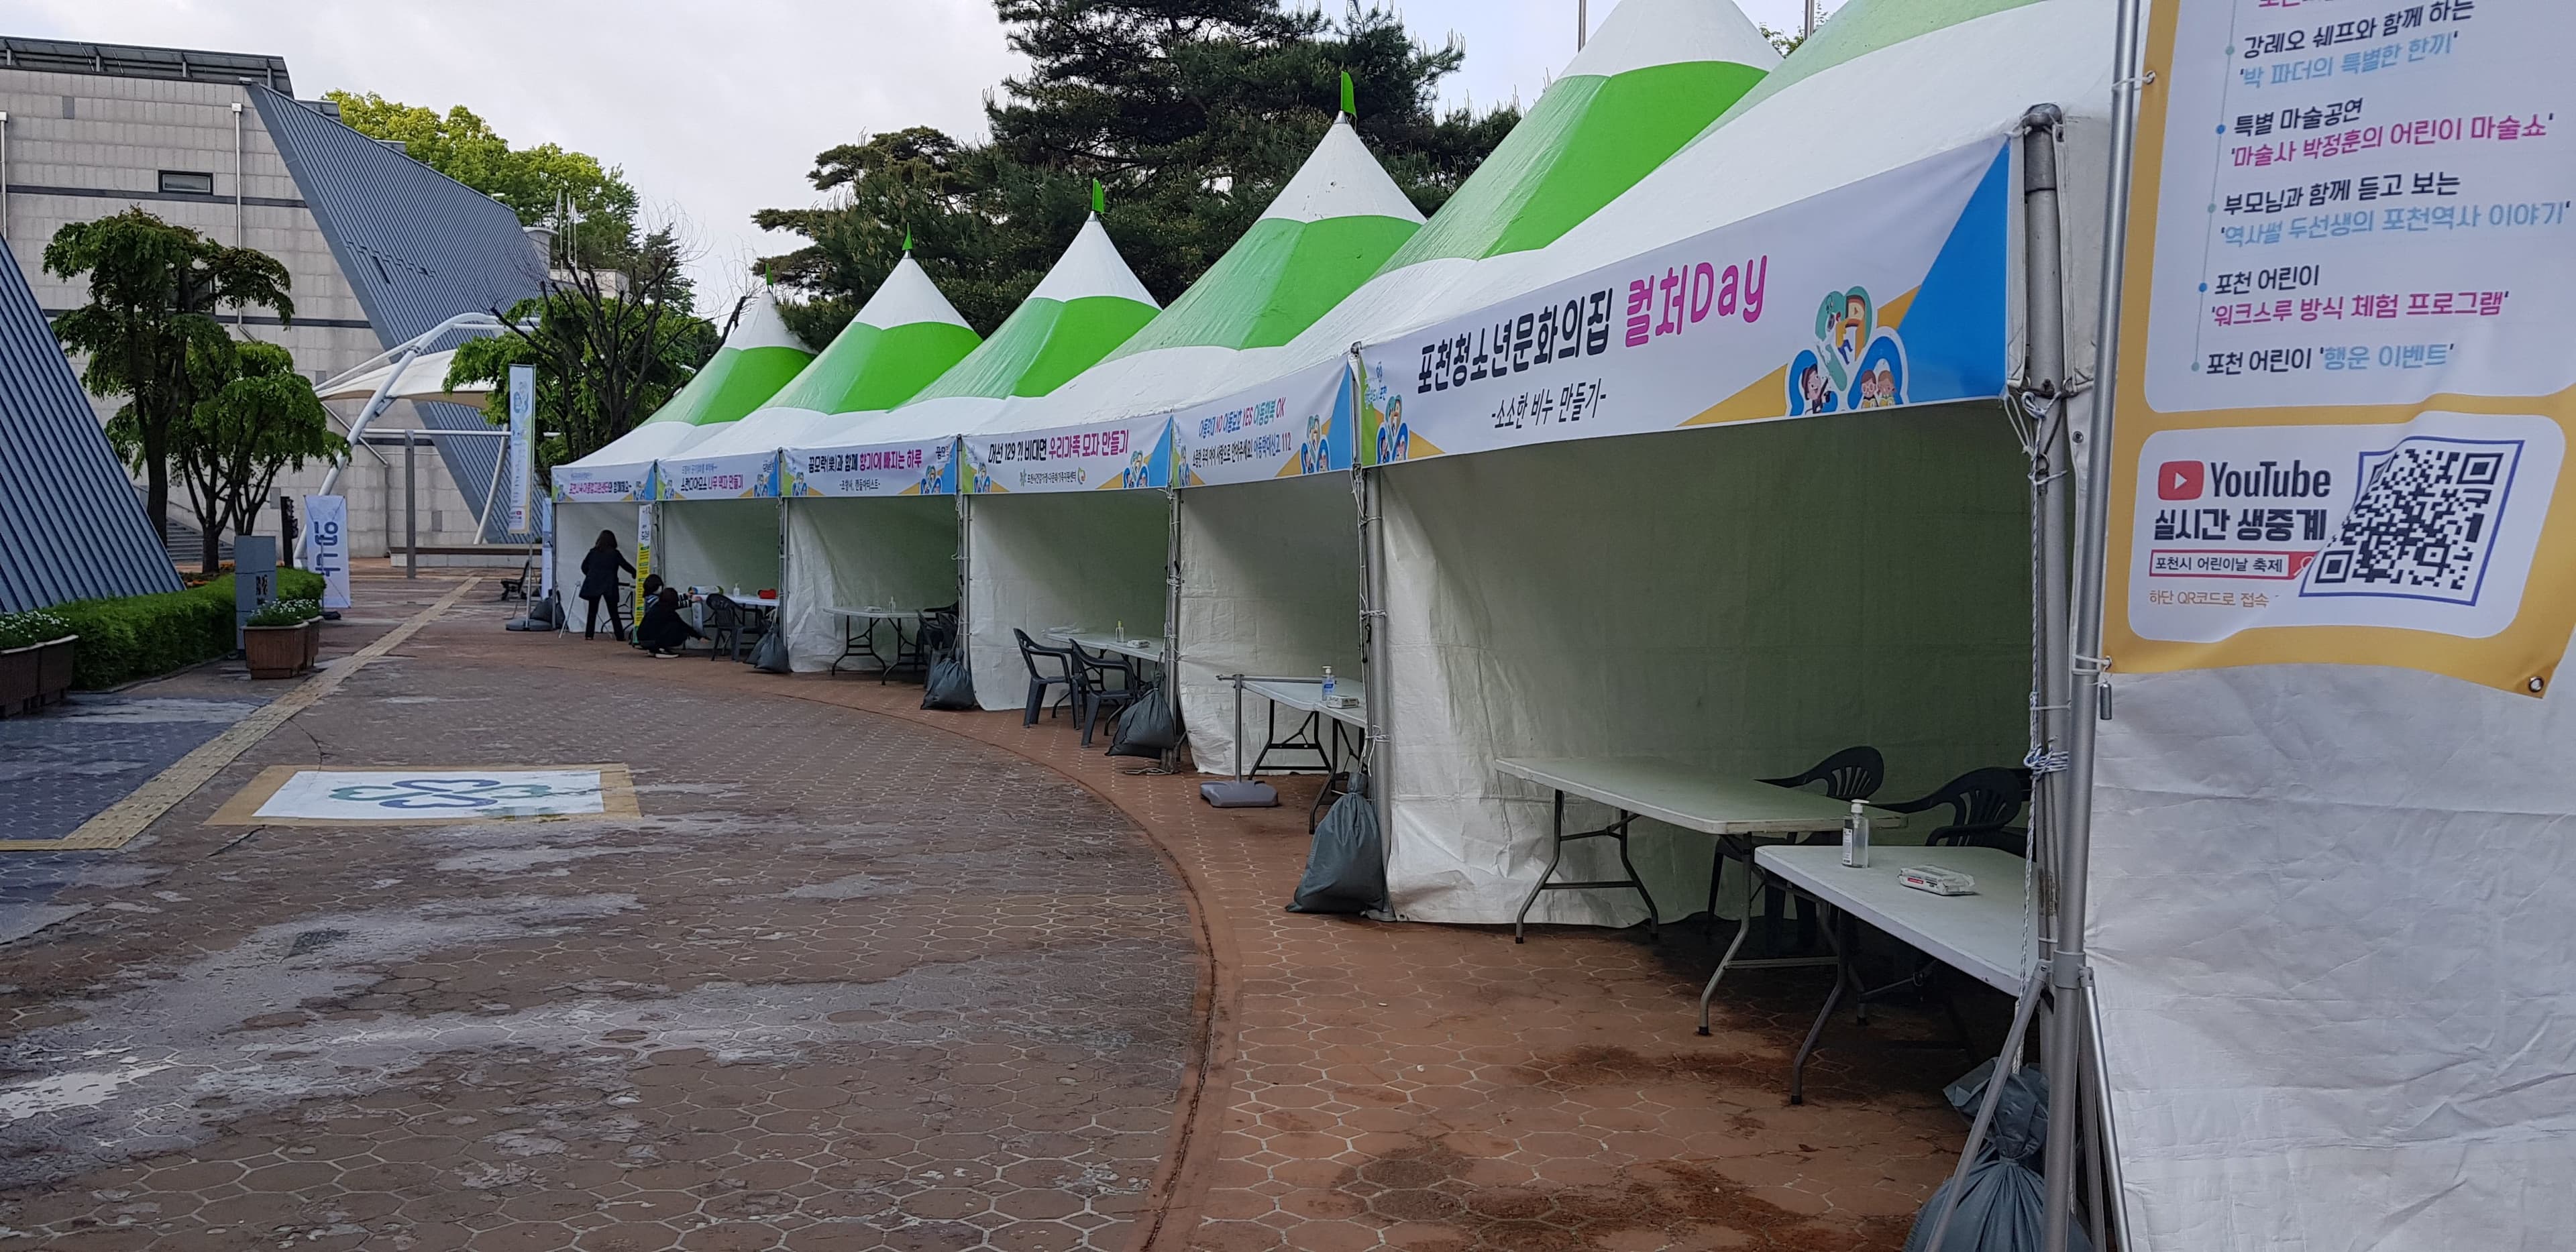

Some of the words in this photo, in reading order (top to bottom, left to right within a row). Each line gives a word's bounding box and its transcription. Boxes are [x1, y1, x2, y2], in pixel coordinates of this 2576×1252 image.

[2243, 30, 2305, 58] 강레오
[2313, 18, 2377, 48] 쉐프와
[2383, 7, 2422, 36] 함께
[2429, 0, 2474, 22] 하는
[2271, 56, 2334, 83] 파더의
[2341, 44, 2401, 74] 특별한
[2234, 111, 2273, 135] 특별
[2281, 98, 2363, 130] 마술공연
[2231, 139, 2296, 168] '마술사
[2303, 126, 2383, 159] 박정훈의
[2390, 118, 2463, 146] 어린이
[2471, 113, 2553, 140] 마술쇼'
[2223, 187, 2304, 217] 부모님과
[2308, 178, 2350, 206] 함께
[2358, 174, 2403, 200] 듣고
[2413, 172, 2461, 196] 보는
[2288, 215, 2373, 239] 두선생의
[2383, 205, 2481, 233] 포천역사
[2489, 201, 2570, 227] 이야기'
[2214, 270, 2251, 294] 포천
[2258, 265, 2319, 291] 어린이
[1417, 287, 1613, 394] 포천청소년문화의집
[1625, 254, 1768, 347] 컬처Day
[2212, 301, 2293, 327] '워크스루
[2300, 296, 2344, 322] 방식
[2351, 294, 2398, 319] 체험
[2406, 292, 2509, 316] 프로그램'
[2206, 351, 2243, 375] 포천
[2249, 347, 2312, 372] 어린이
[2379, 343, 2454, 367] 이벤트'
[1216, 415, 1223, 433] NO
[1242, 407, 1253, 427] YES
[1277, 397, 1286, 418] OK
[1532, 394, 1553, 426] 비누
[988, 444, 1003, 464] 머선
[1005, 443, 1015, 461] 129
[1024, 438, 1047, 461] 비대면
[1049, 435, 1080, 459] 우리가족
[1082, 433, 1100, 457] 모자
[1102, 429, 1129, 456] 만들기
[1282, 432, 1291, 451] 112
[845, 453, 858, 472] 함께
[860, 451, 881, 471] 향기에
[883, 450, 904, 470] 빠지는
[907, 449, 922, 469] 하루
[729, 474, 743, 490] 만들기
[2211, 459, 2331, 498] YouTube
[2154, 509, 2230, 541] 실시간
[2238, 508, 2327, 542] 생중계
[2155, 557, 2192, 571] 포천시
[2196, 556, 2247, 572] 어린이날
[2252, 557, 2283, 573] 축제
[2149, 589, 2174, 605] 하단
[2177, 591, 2235, 606] QR코드로
[2241, 592, 2269, 609] 접속
